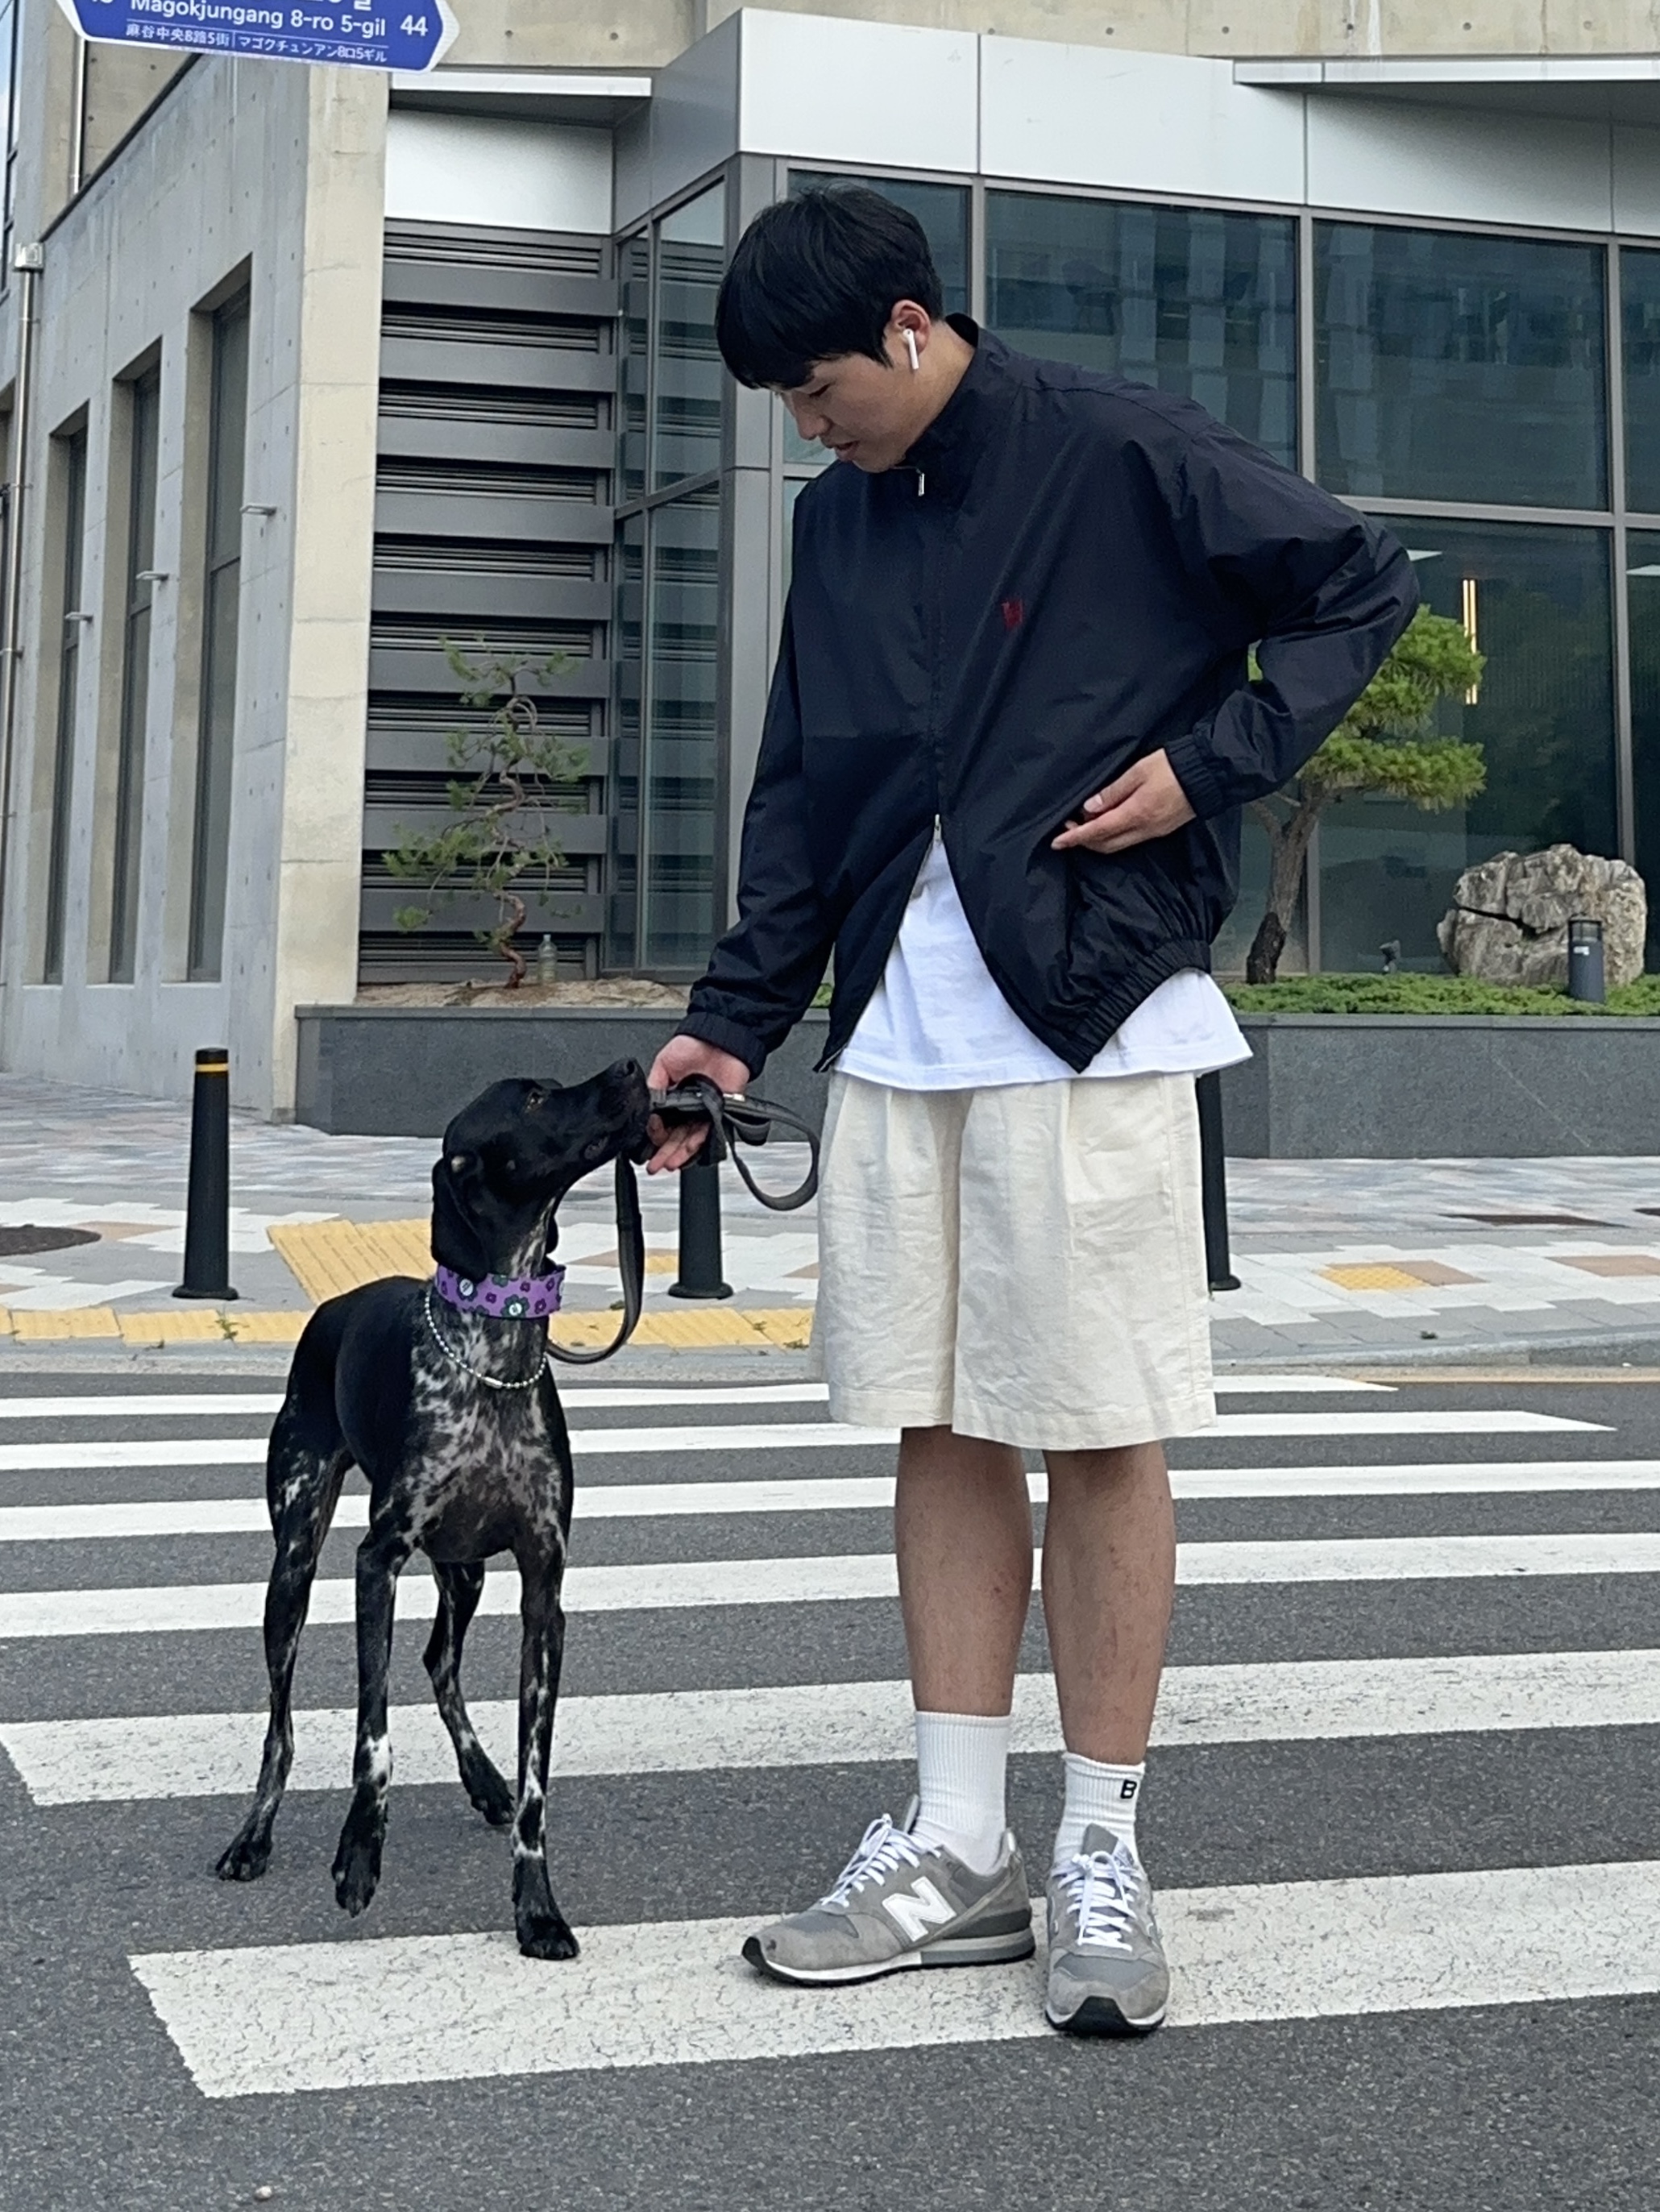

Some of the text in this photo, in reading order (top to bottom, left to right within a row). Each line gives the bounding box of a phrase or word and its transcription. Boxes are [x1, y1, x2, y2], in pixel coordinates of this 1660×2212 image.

[131, 0, 429, 39] Magokjungang 8-ro 5-gil 44
[1120, 1778, 1138, 1799] B
[882, 1875, 957, 1942] N
